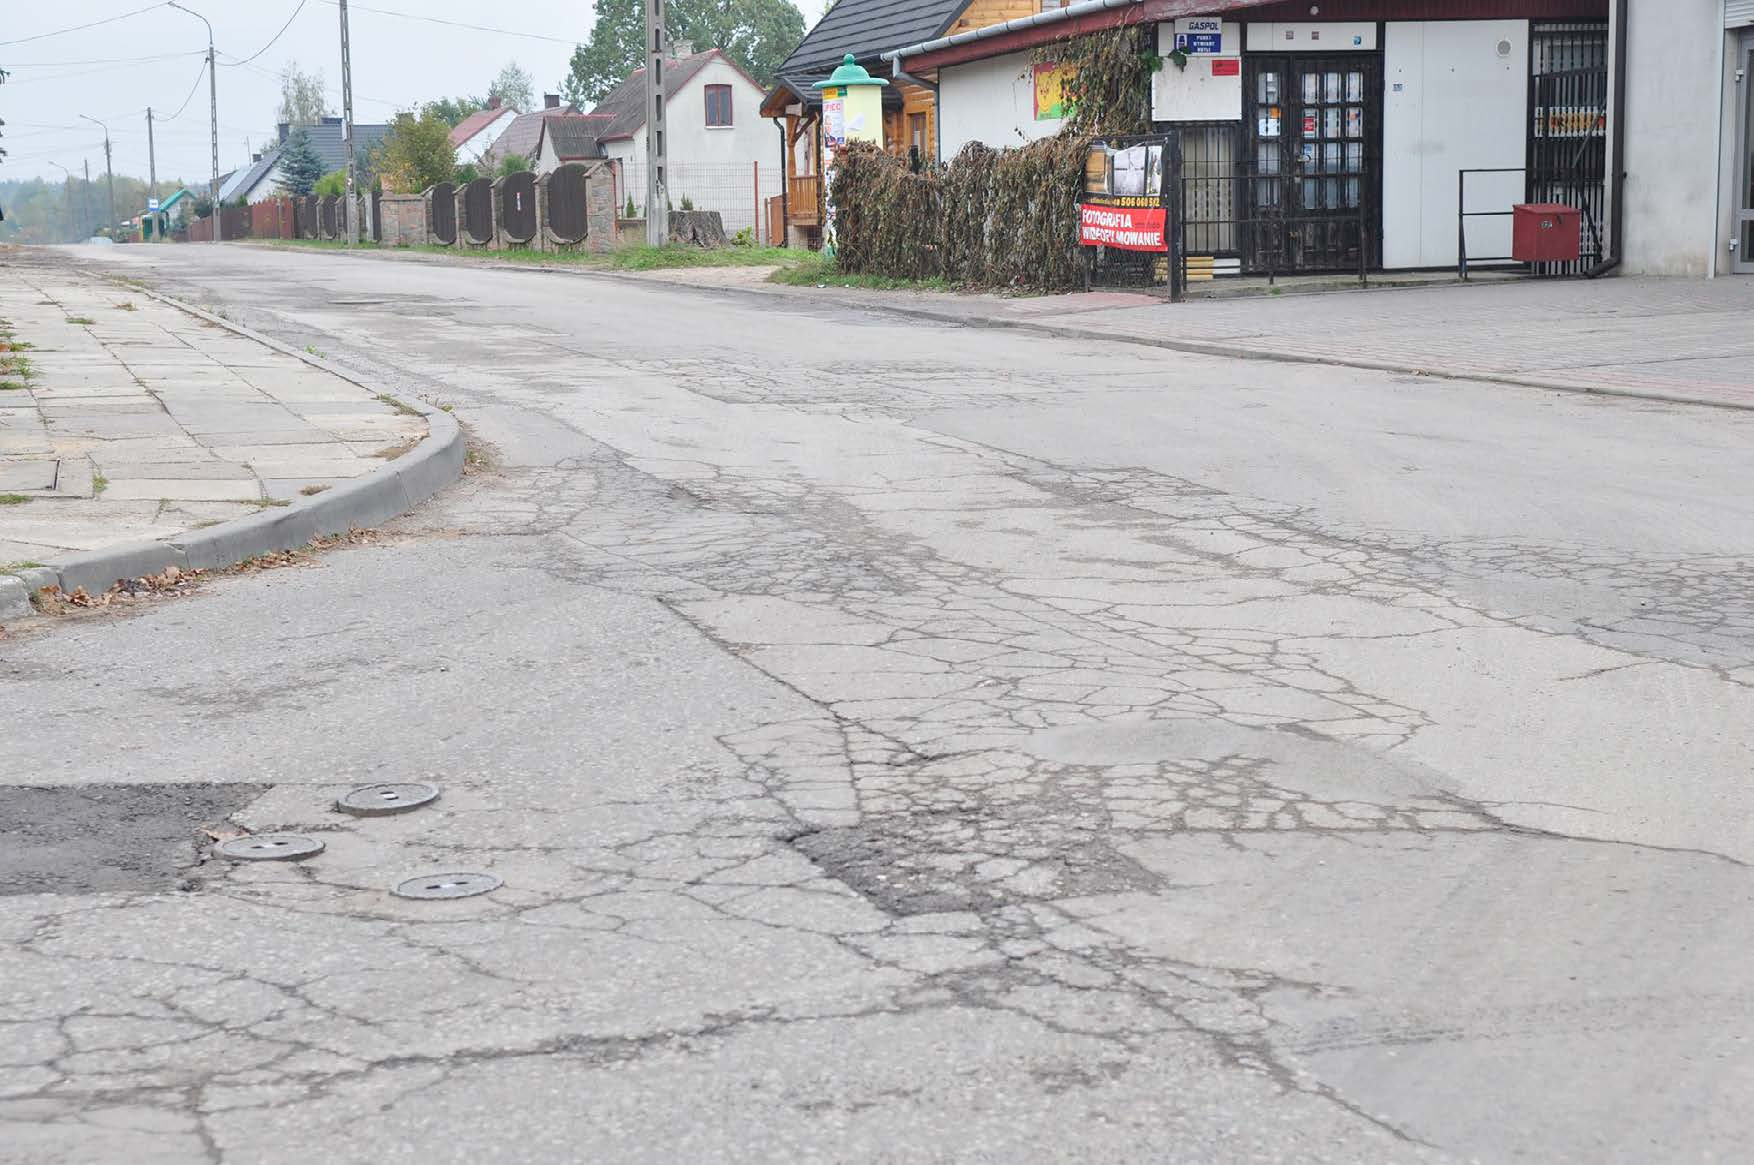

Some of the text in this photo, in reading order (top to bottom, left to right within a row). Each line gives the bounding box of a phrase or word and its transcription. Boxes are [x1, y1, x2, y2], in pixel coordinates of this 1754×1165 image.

[1189, 22, 1219, 30] GASPOL
[1121, 197, 1136, 207] 506
[1082, 209, 1132, 228] FOTOGRAFIA
